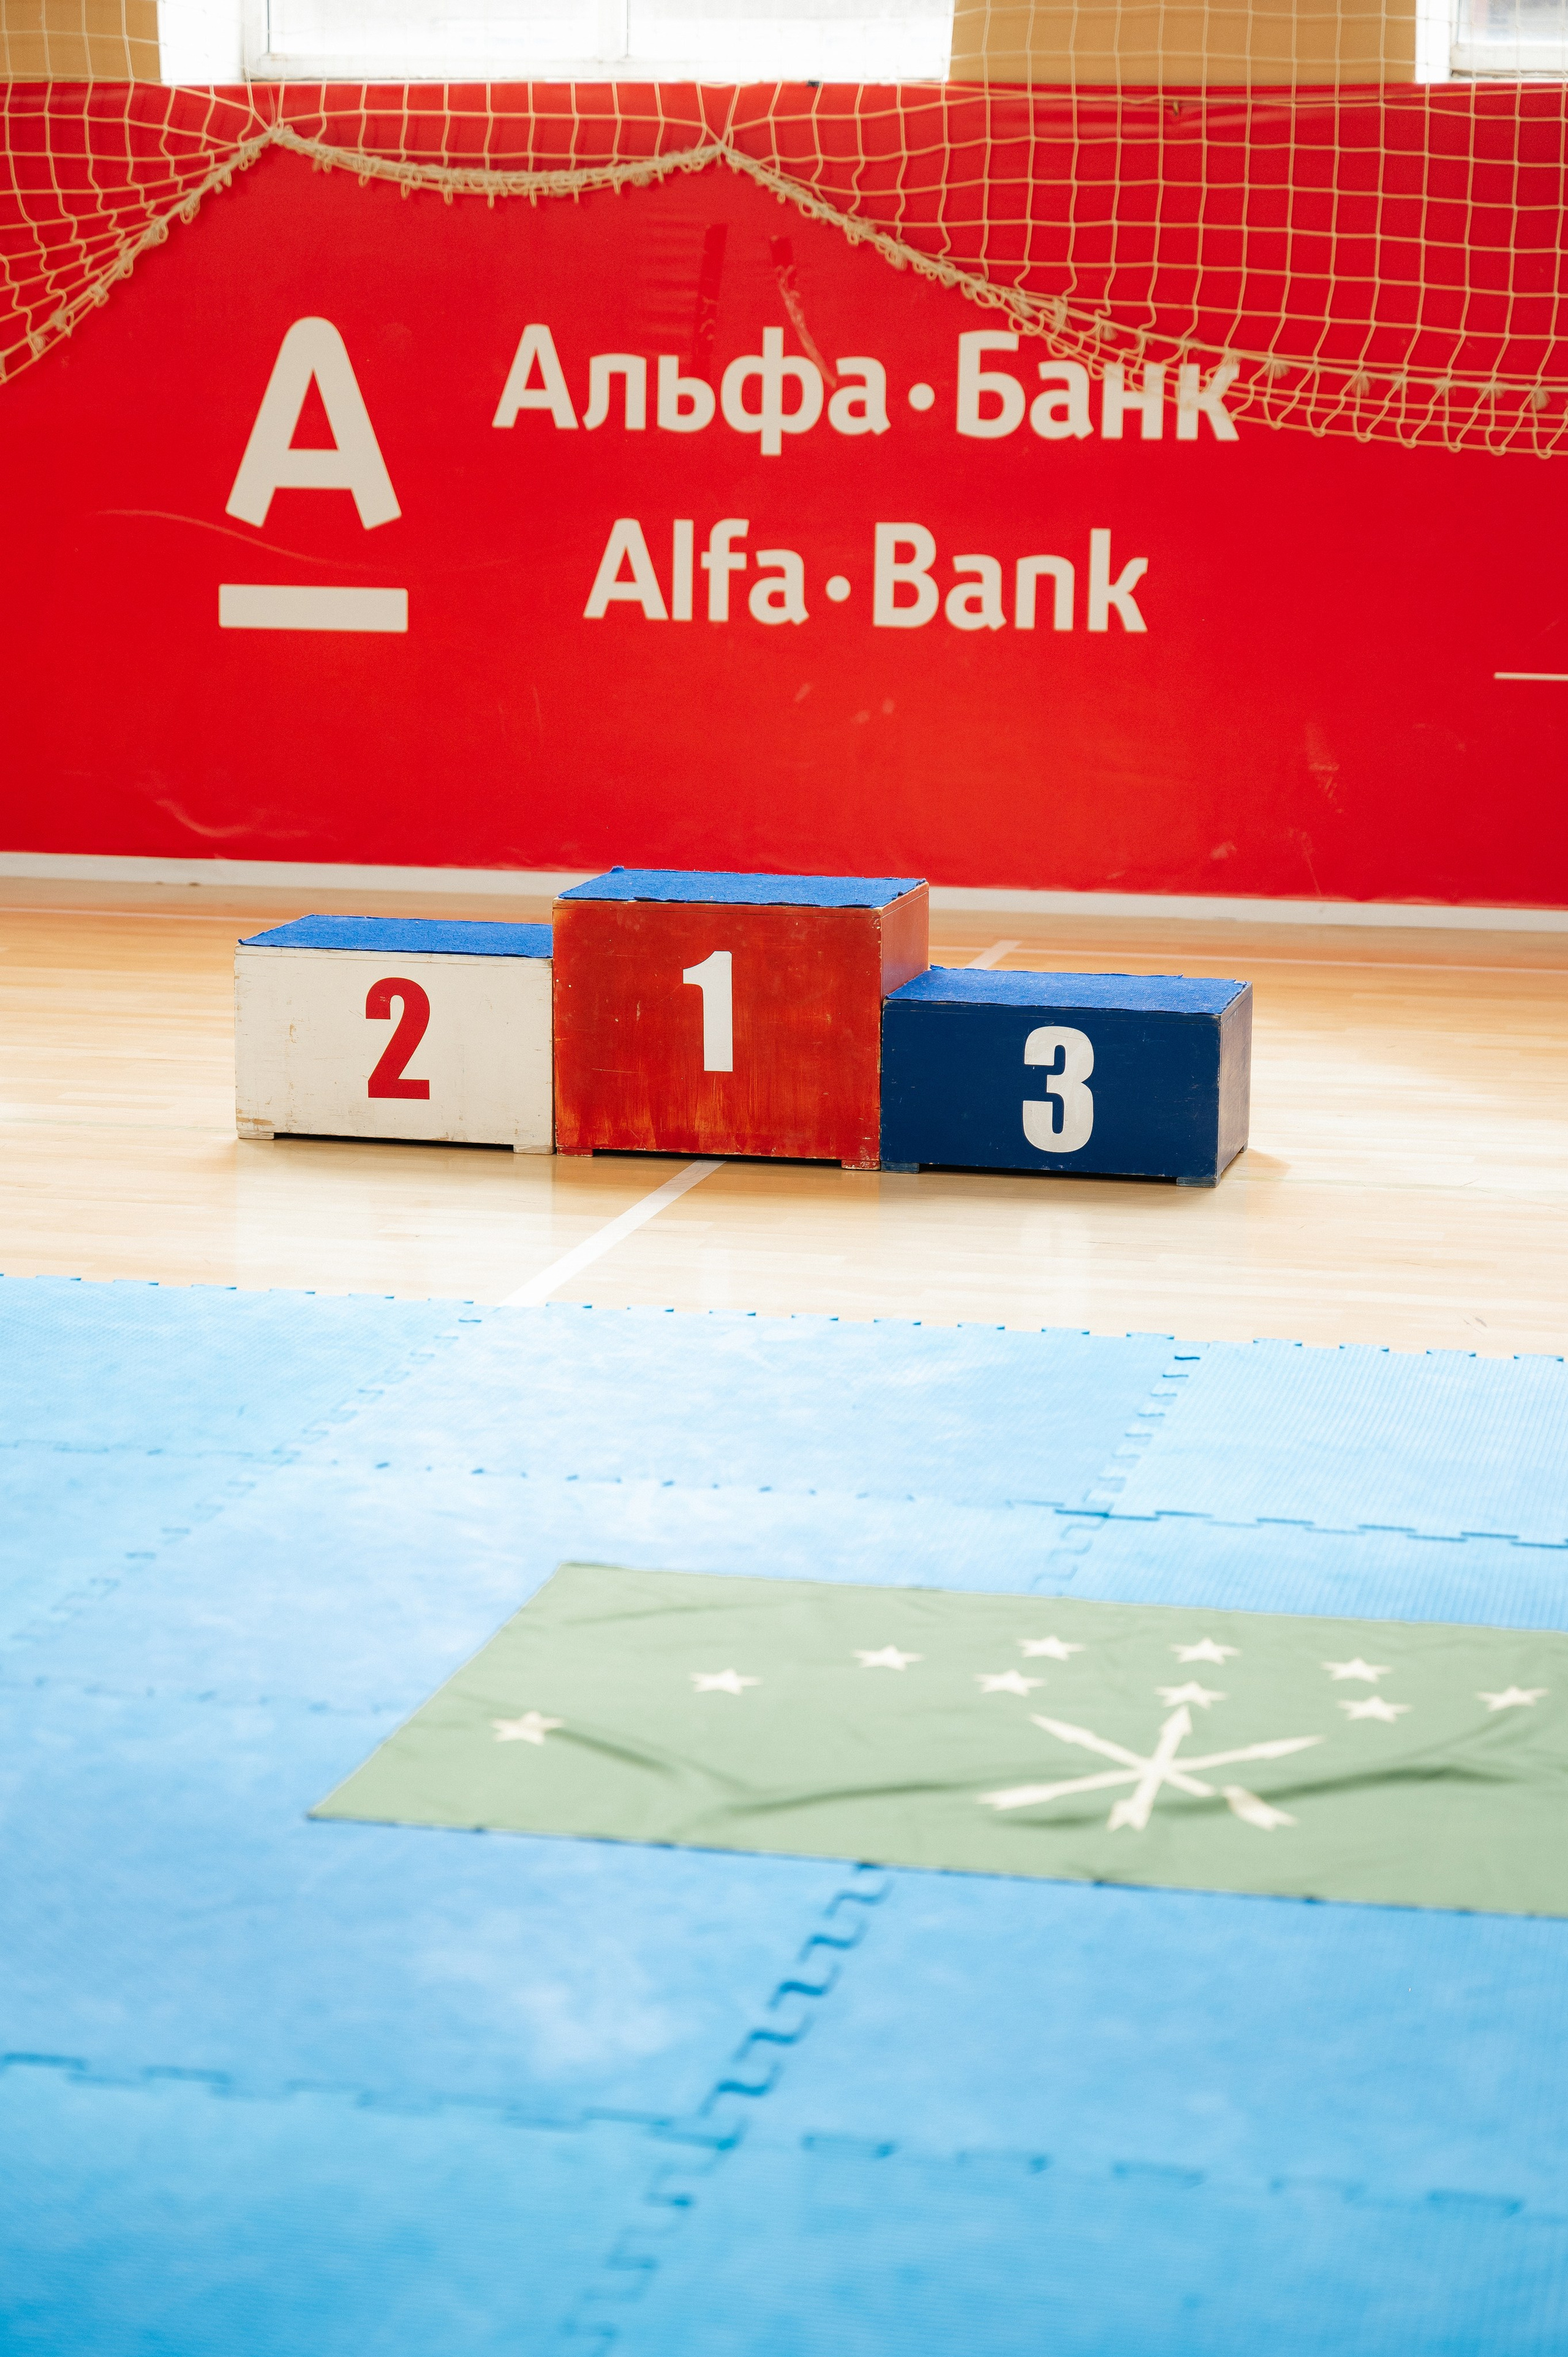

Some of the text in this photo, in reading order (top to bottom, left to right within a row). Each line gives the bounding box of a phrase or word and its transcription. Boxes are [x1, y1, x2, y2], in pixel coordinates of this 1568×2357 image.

[366, 977, 430, 1099] 2
[682, 951, 733, 1072] 1
[1022, 1025, 1095, 1153] 3
